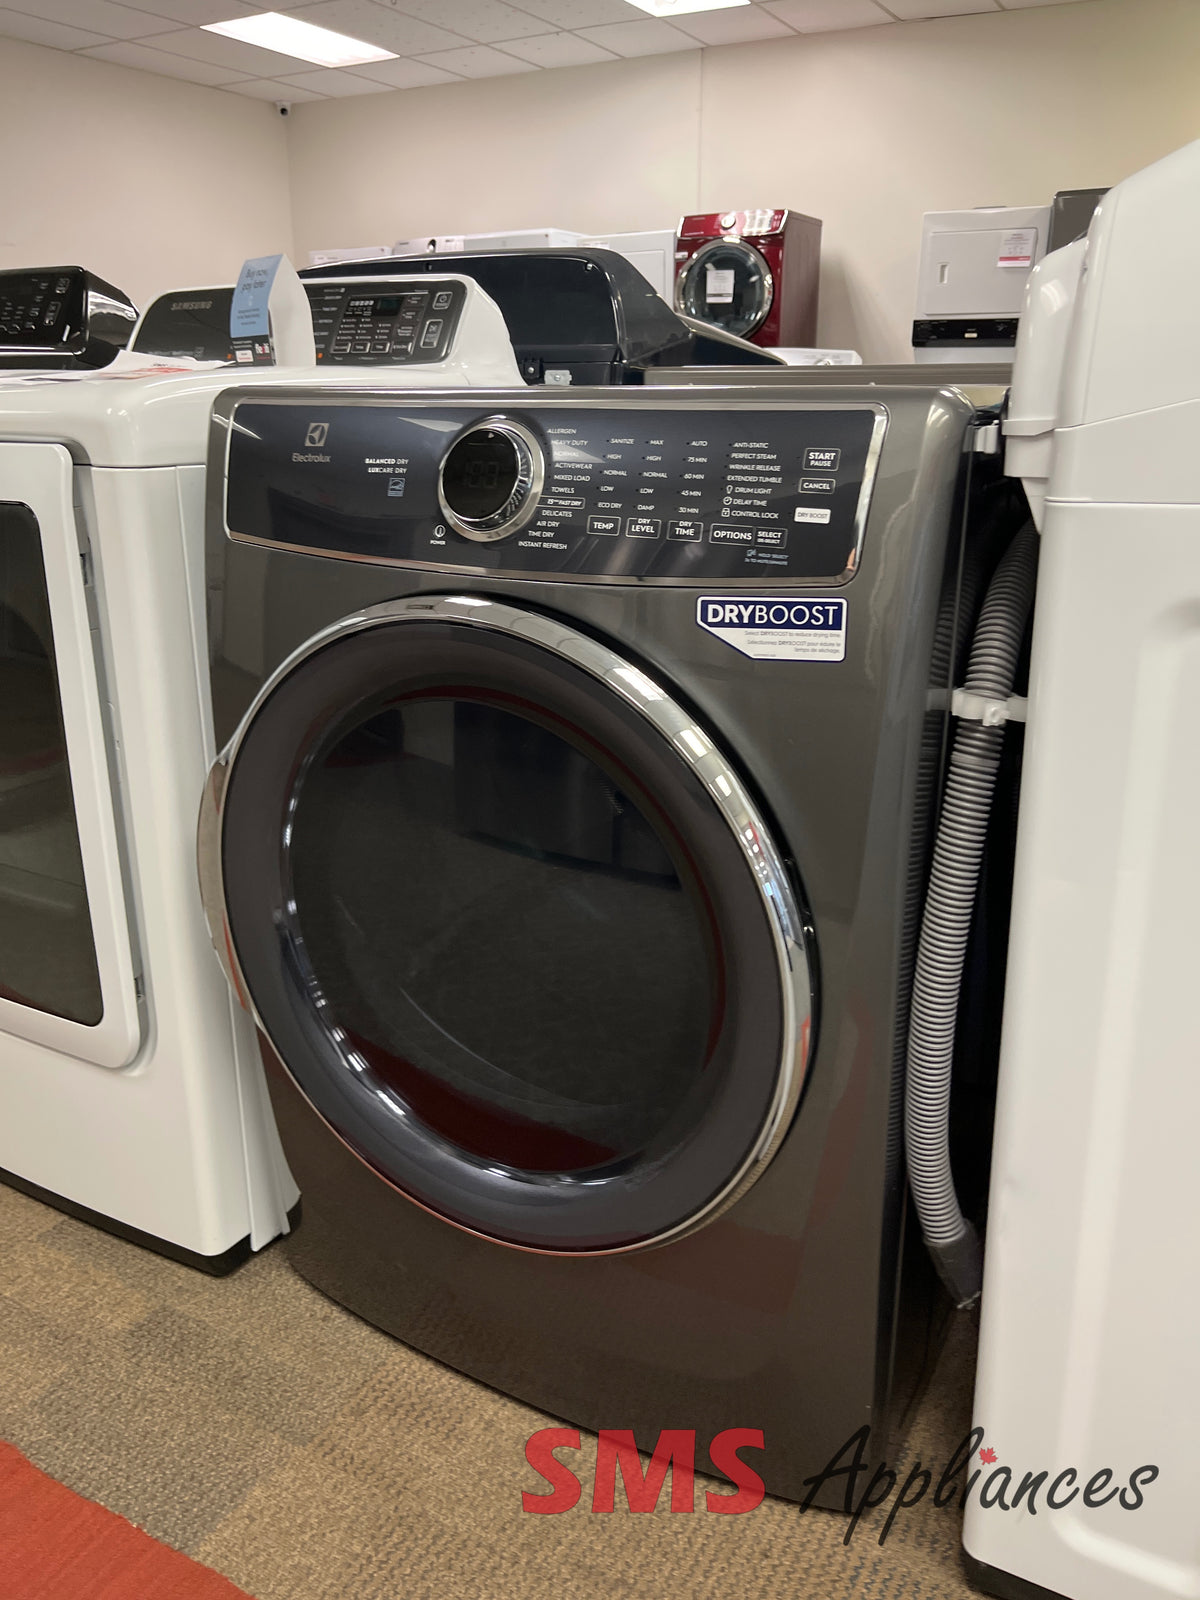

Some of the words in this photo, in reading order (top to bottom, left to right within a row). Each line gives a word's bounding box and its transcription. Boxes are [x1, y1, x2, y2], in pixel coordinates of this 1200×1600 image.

[170, 301, 213, 310] SAMSUNG
[291, 453, 332, 463] Electrolux
[809, 452, 836, 460] START
[542, 510, 573, 518] DELICATES
[631, 525, 655, 533] LEVEL
[713, 530, 752, 540] OPTIONS
[707, 604, 839, 625] DRYBOOST
